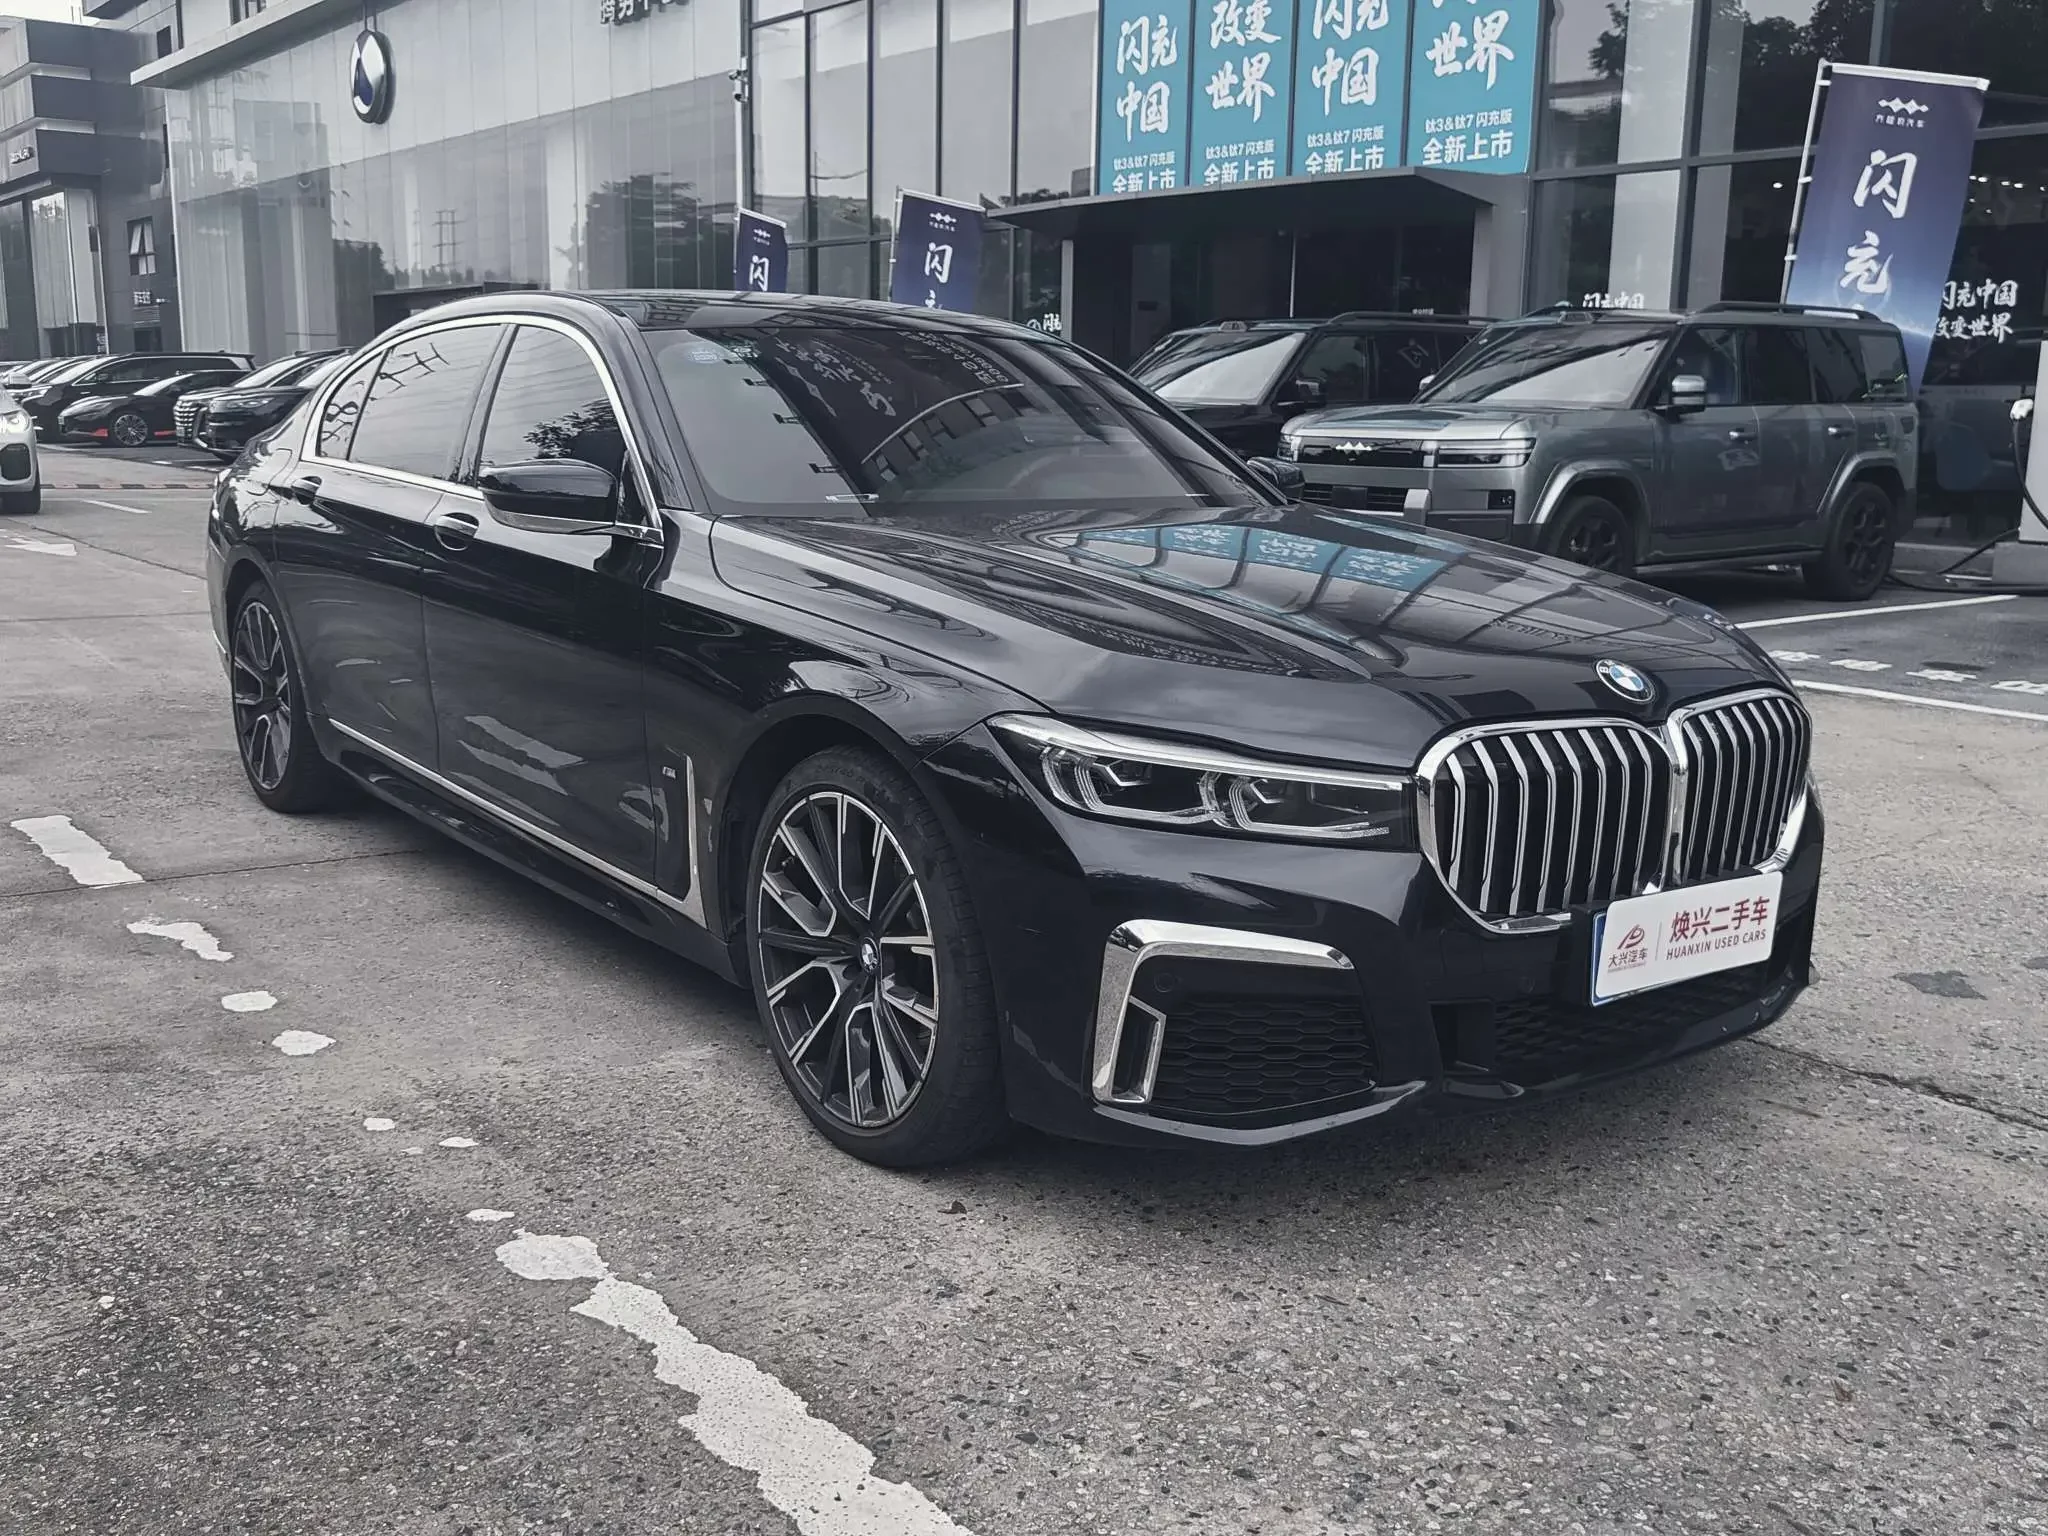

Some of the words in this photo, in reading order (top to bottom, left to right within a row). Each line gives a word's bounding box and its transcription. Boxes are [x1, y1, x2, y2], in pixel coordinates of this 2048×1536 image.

[1116, 14, 1178, 76] 闪充
[1424, 9, 1515, 91] 世界
[1205, 52, 1276, 124] 世界
[1311, 47, 1380, 117] 中国
[1116, 80, 1171, 143] 中国
[1203, 157, 1276, 187] 全新上市
[1304, 144, 1385, 175] 全新上市
[1421, 129, 1514, 166] 全新上市
[1839, 149, 1919, 310] 闪充
[749, 255, 770, 292] 闪
[1666, 940, 1712, 961] HUANXIN
[1714, 936, 1740, 951] USED
[1742, 929, 1767, 944] CARS
[1668, 895, 1770, 943] 焕兴二手车
